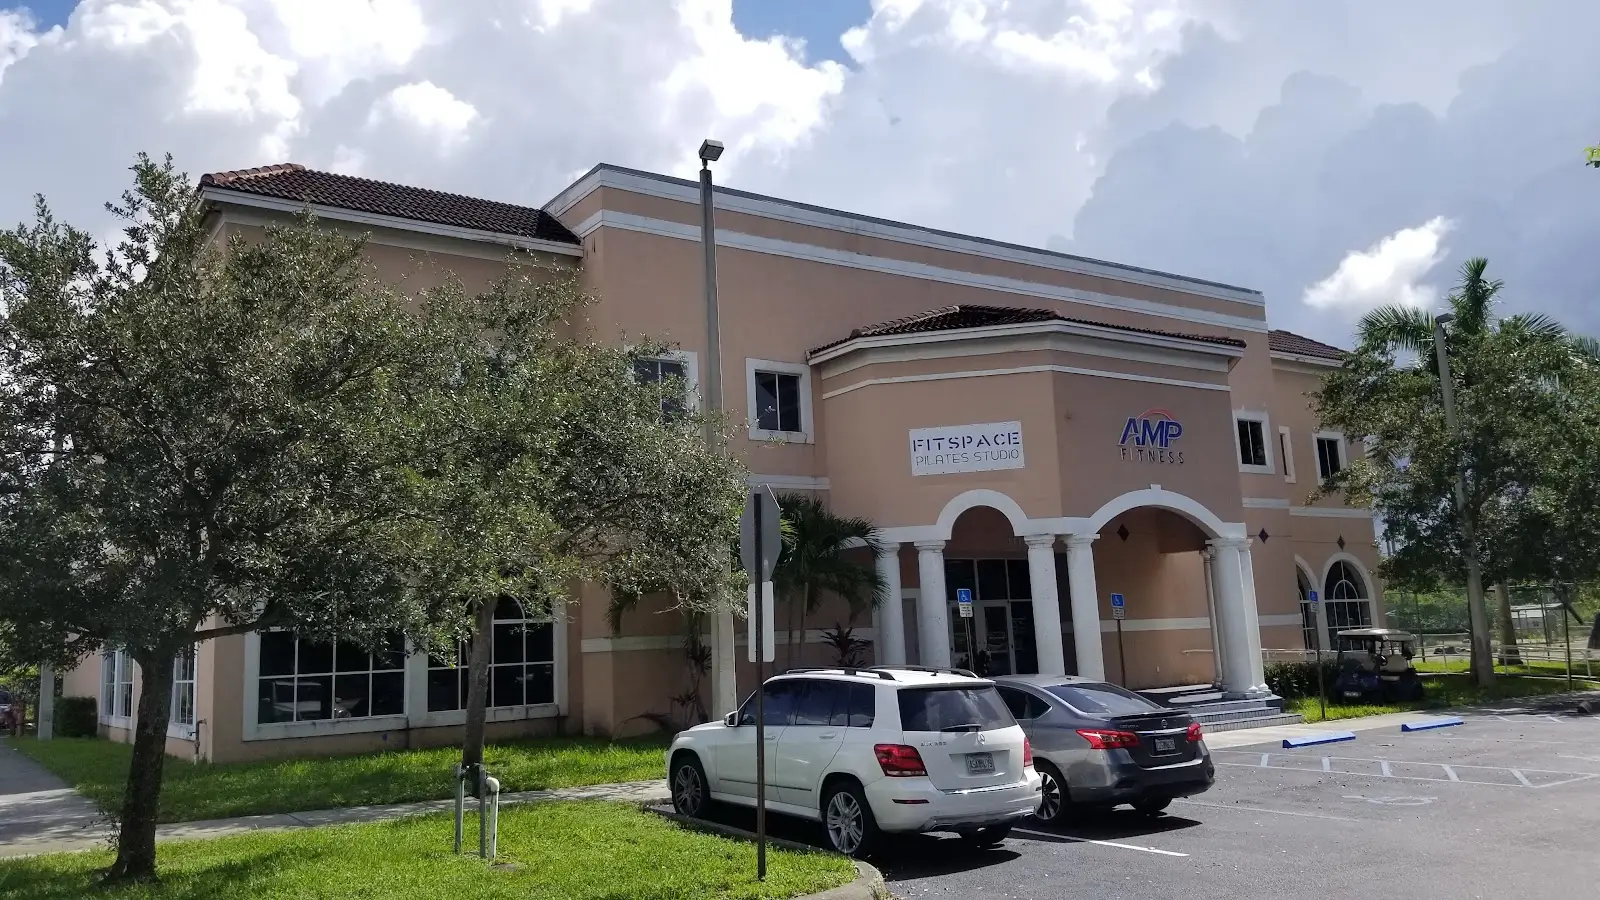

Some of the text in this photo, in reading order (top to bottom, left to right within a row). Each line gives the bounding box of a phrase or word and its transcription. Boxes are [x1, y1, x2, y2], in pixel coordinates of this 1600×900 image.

[913, 432, 1020, 452] FITSPACE
[1118, 416, 1183, 449] AMP
[915, 448, 1019, 466] PILATES STUDIO
[1120, 447, 1184, 464] FITNESS
